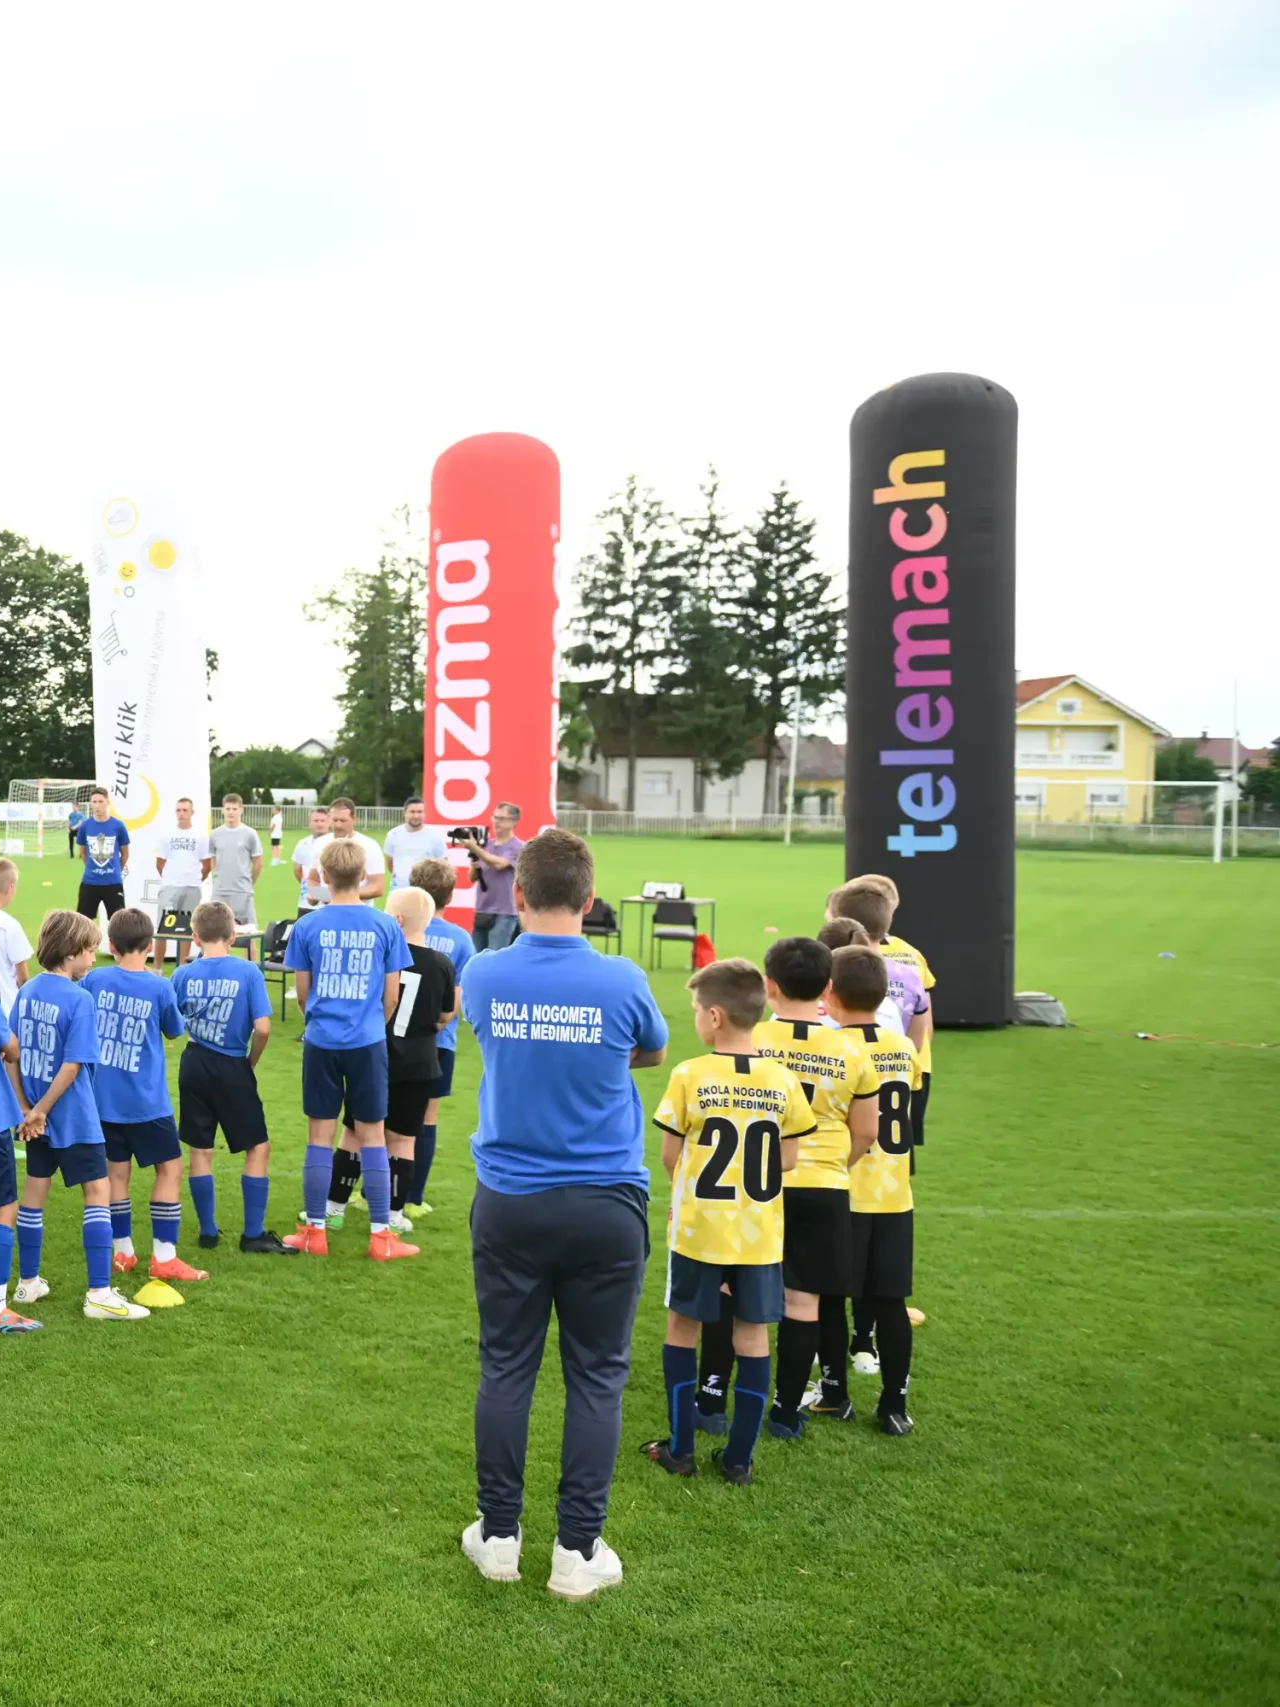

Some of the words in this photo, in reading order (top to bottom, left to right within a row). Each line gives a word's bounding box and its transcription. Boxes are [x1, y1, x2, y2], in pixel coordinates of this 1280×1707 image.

[873, 449, 959, 857] telemach
[116, 700, 138, 743] klik
[111, 748, 131, 799] žuti
[164, 915, 176, 928] 0
[320, 930, 337, 948] GO
[340, 930, 375, 948] HARD
[320, 948, 342, 973] OR
[348, 949, 372, 974] GO
[186, 979, 202, 997] GO
[207, 979, 240, 997] HARD
[317, 973, 369, 1000] HOME
[31, 999, 59, 1024] HARD
[98, 990, 115, 1010] GO
[117, 995, 152, 1019] HARD
[206, 997, 234, 1024] GO
[490, 998, 529, 1021] ŠKOLA
[532, 1004, 603, 1025] NOGOMETA
[19, 1018, 34, 1047] R
[37, 1021, 56, 1054] GO
[96, 1010, 119, 1039] OR
[121, 1016, 147, 1045] GO
[492, 1021, 528, 1040] DONJE
[530, 1024, 602, 1044] MEĐIMURJE
[99, 1038, 143, 1073] OME
[758, 1048, 785, 1059] KOLA
[788, 1050, 846, 1069] NOGOMETA
[786, 1062, 846, 1081] MEĐIMURJE
[697, 1086, 730, 1097] ŠKOLA
[733, 1086, 787, 1102] NOGOMETA
[699, 1098, 730, 1110] DONJE
[733, 1099, 786, 1115] MEĐIMURJE
[695, 1116, 783, 1203] 20
